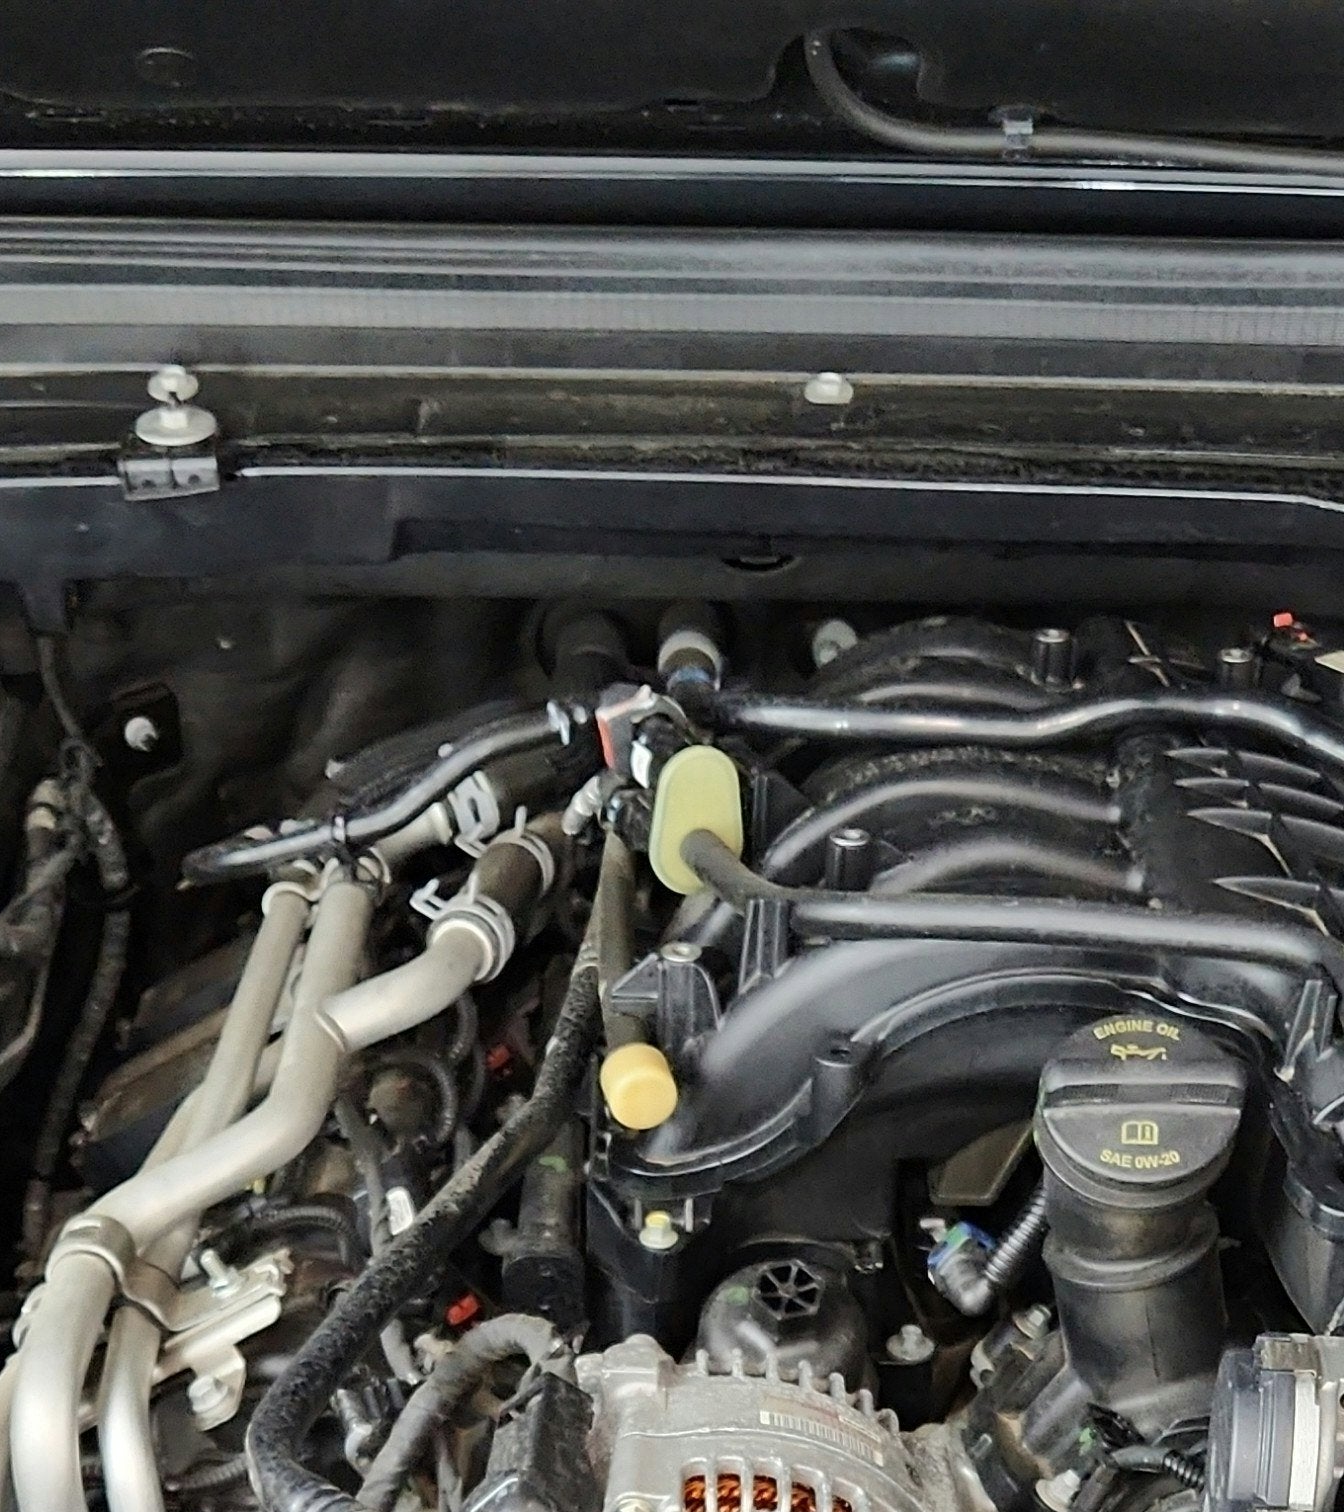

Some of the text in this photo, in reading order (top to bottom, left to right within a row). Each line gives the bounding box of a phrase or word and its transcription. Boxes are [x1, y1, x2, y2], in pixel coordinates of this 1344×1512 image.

[1093, 1019, 1180, 1041] ENGINE OIL
[1100, 1149, 1181, 1169] SAE 0W-20
